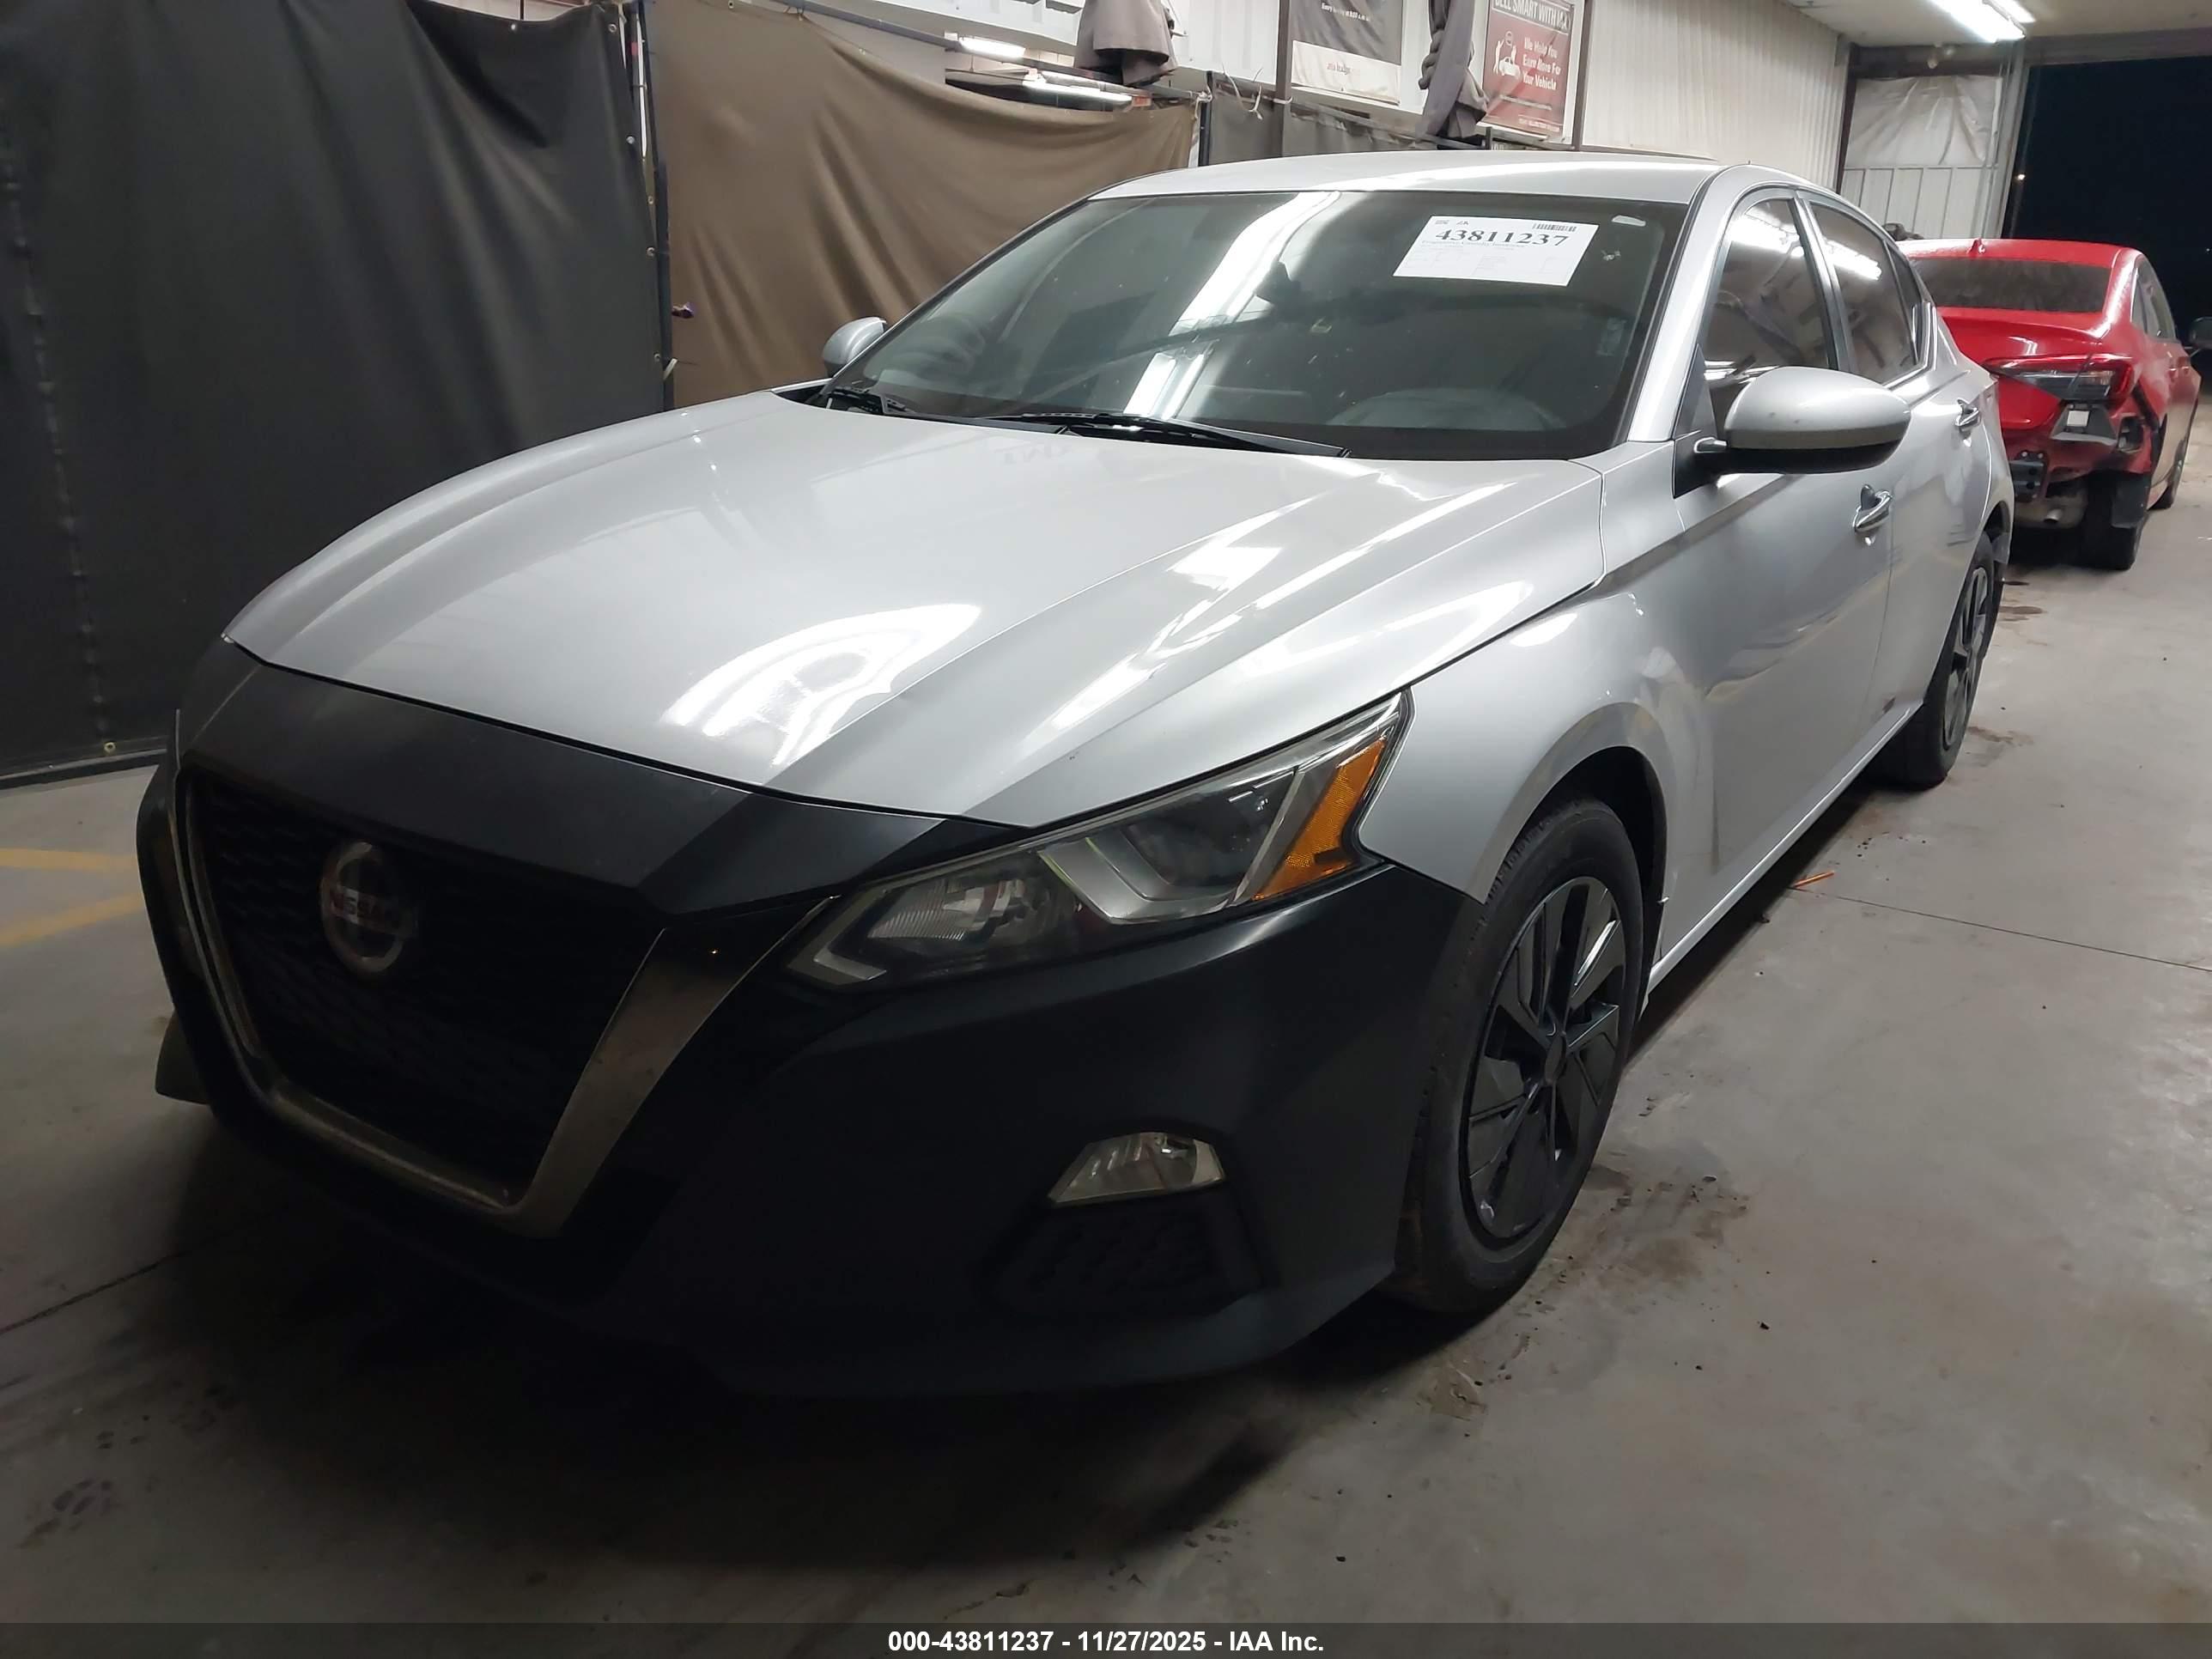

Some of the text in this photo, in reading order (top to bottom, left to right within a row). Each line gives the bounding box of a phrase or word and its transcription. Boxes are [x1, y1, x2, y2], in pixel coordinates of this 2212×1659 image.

[1512, 0, 1538, 19] SMART
[1534, 74, 1557, 90] Vehicle
[1436, 229, 1569, 246] 43811237
